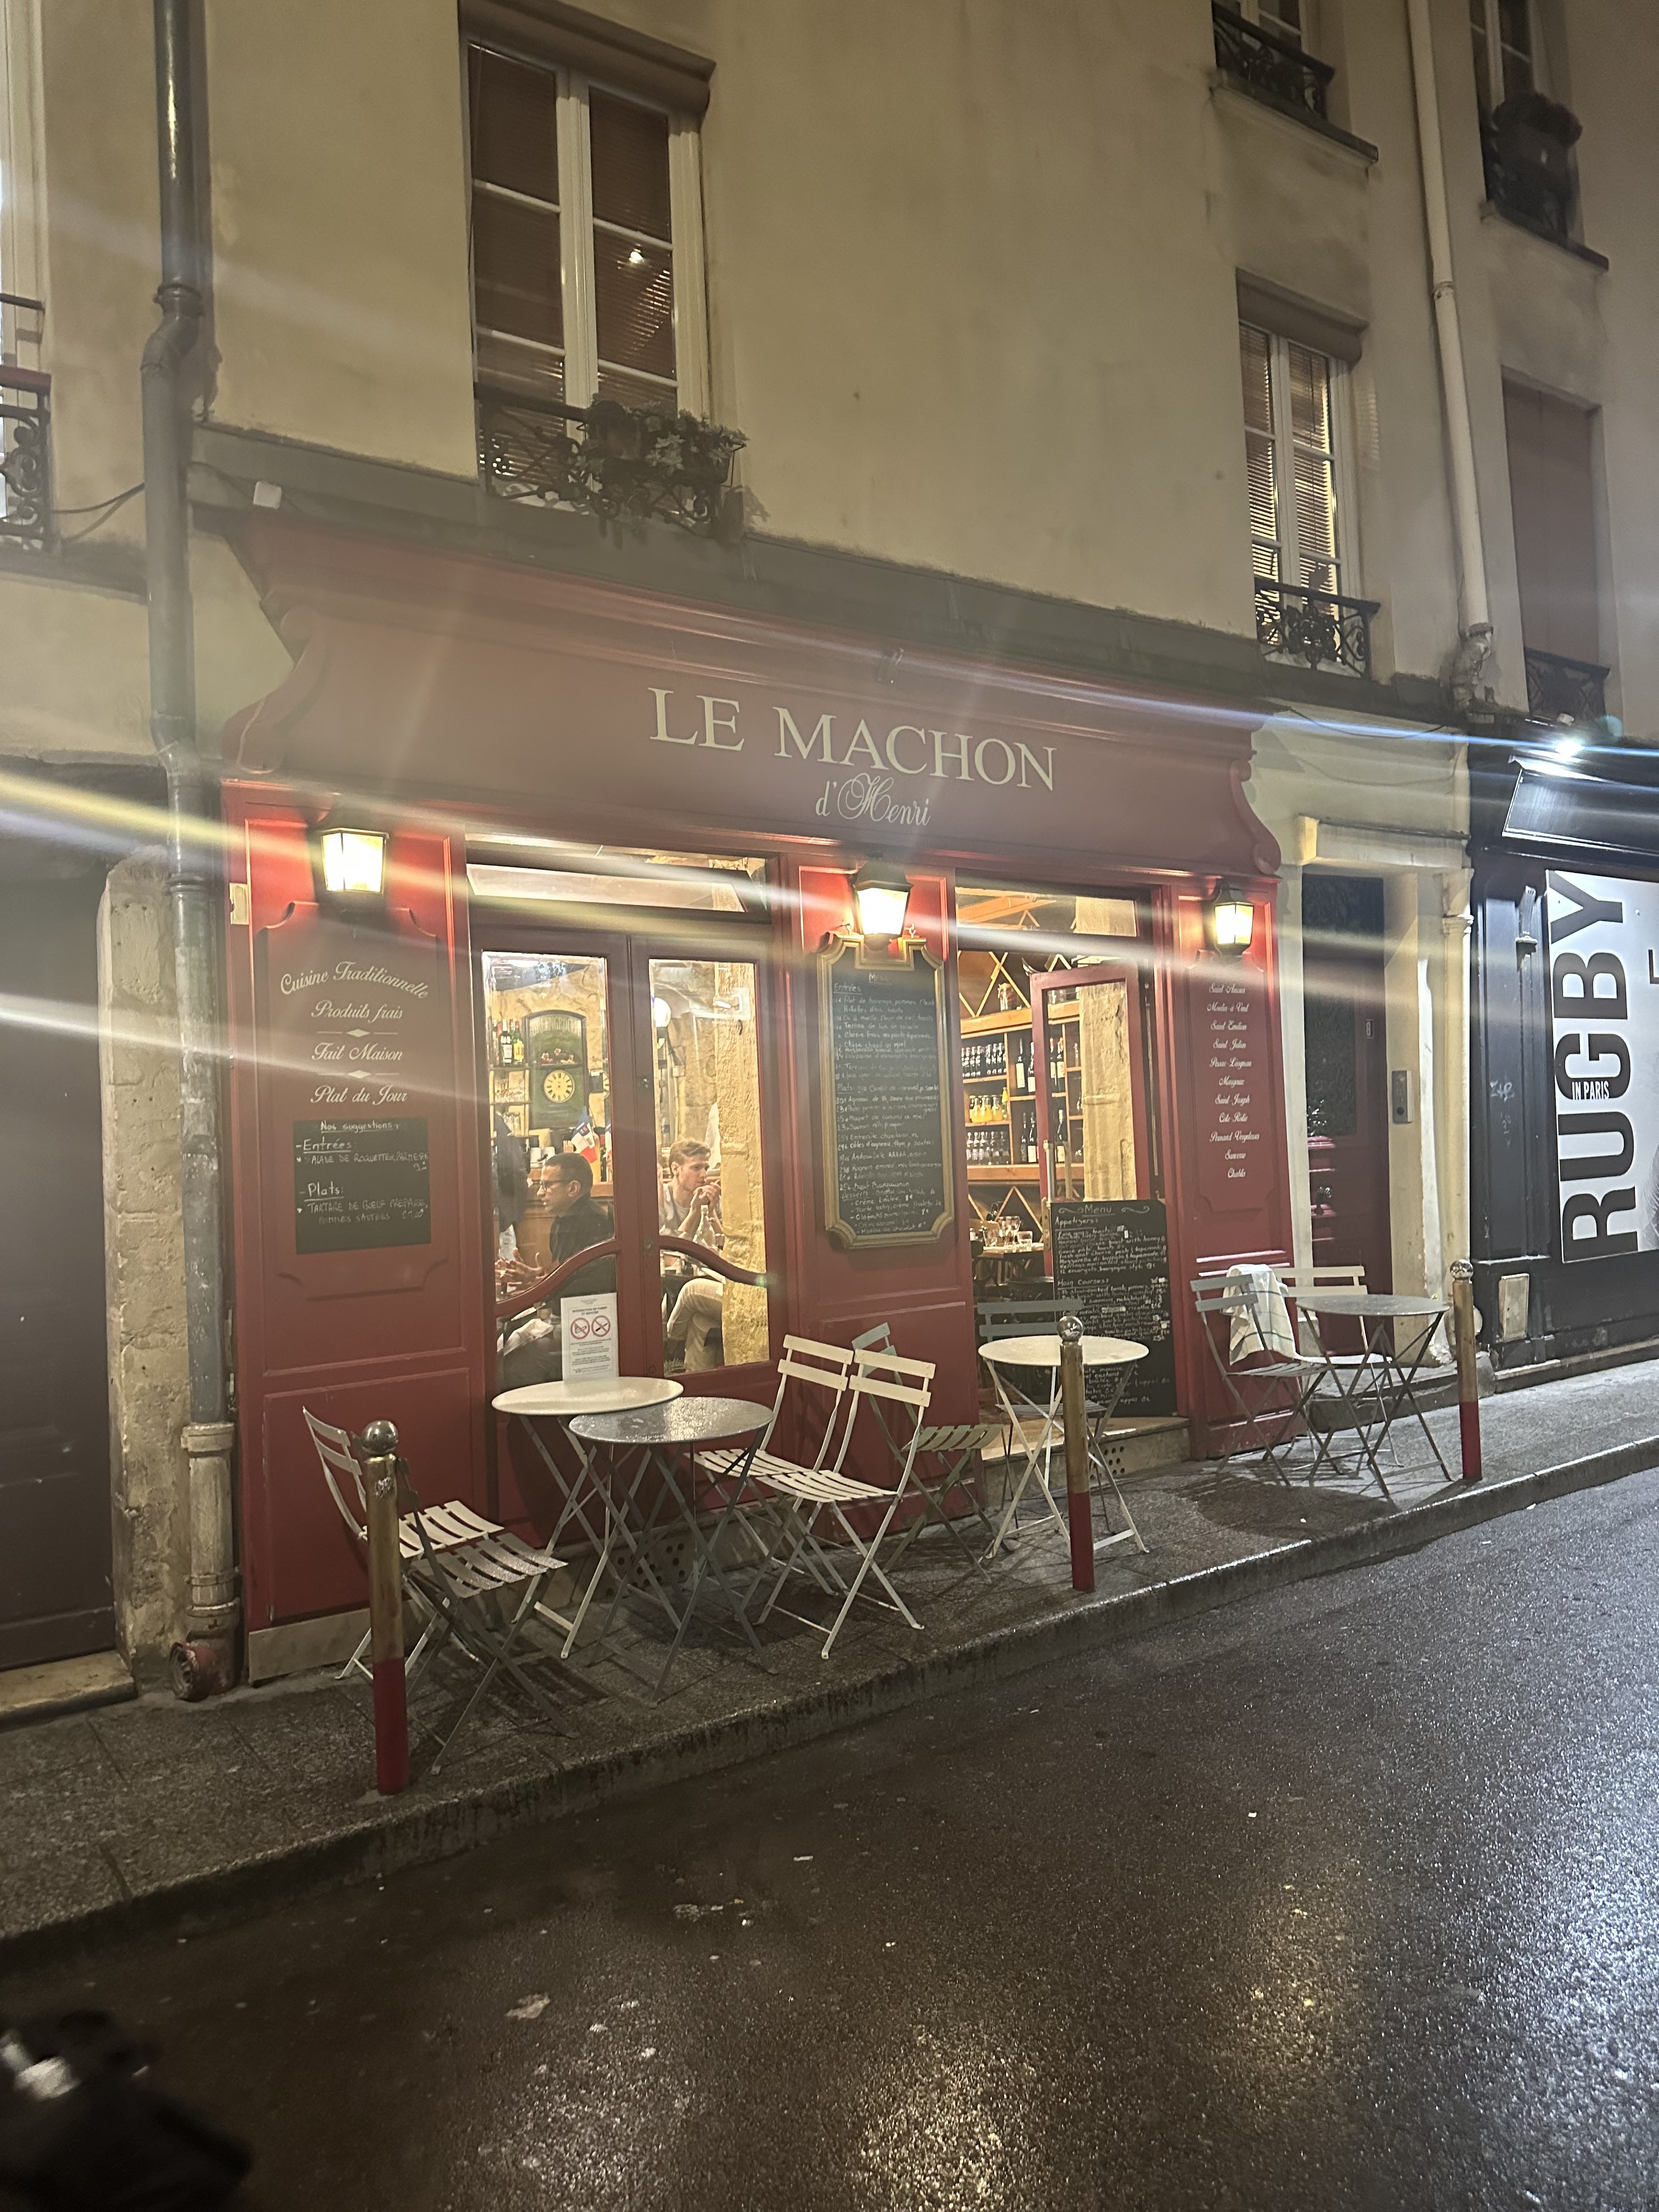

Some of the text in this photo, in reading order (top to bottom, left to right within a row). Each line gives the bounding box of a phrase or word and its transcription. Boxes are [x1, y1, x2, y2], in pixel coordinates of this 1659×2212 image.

[648, 687, 1057, 792] LE MACHON
[815, 772, 931, 826] d'Henri
[280, 961, 428, 998] Cuisine Traditionnelle
[311, 1000, 403, 1023] Produits frais
[312, 1042, 404, 1060] Fait Maison
[1548, 871, 1639, 1262] RUGBY
[310, 1085, 408, 1105] Plat du Jour
[1572, 1081, 1610, 1101] IN PARIS
[320, 1120, 336, 1131] Nos
[339, 1154, 350, 1163] DE
[1228, 1167, 1245, 1178] Chablis
[1085, 1204, 1111, 1214] Menu
